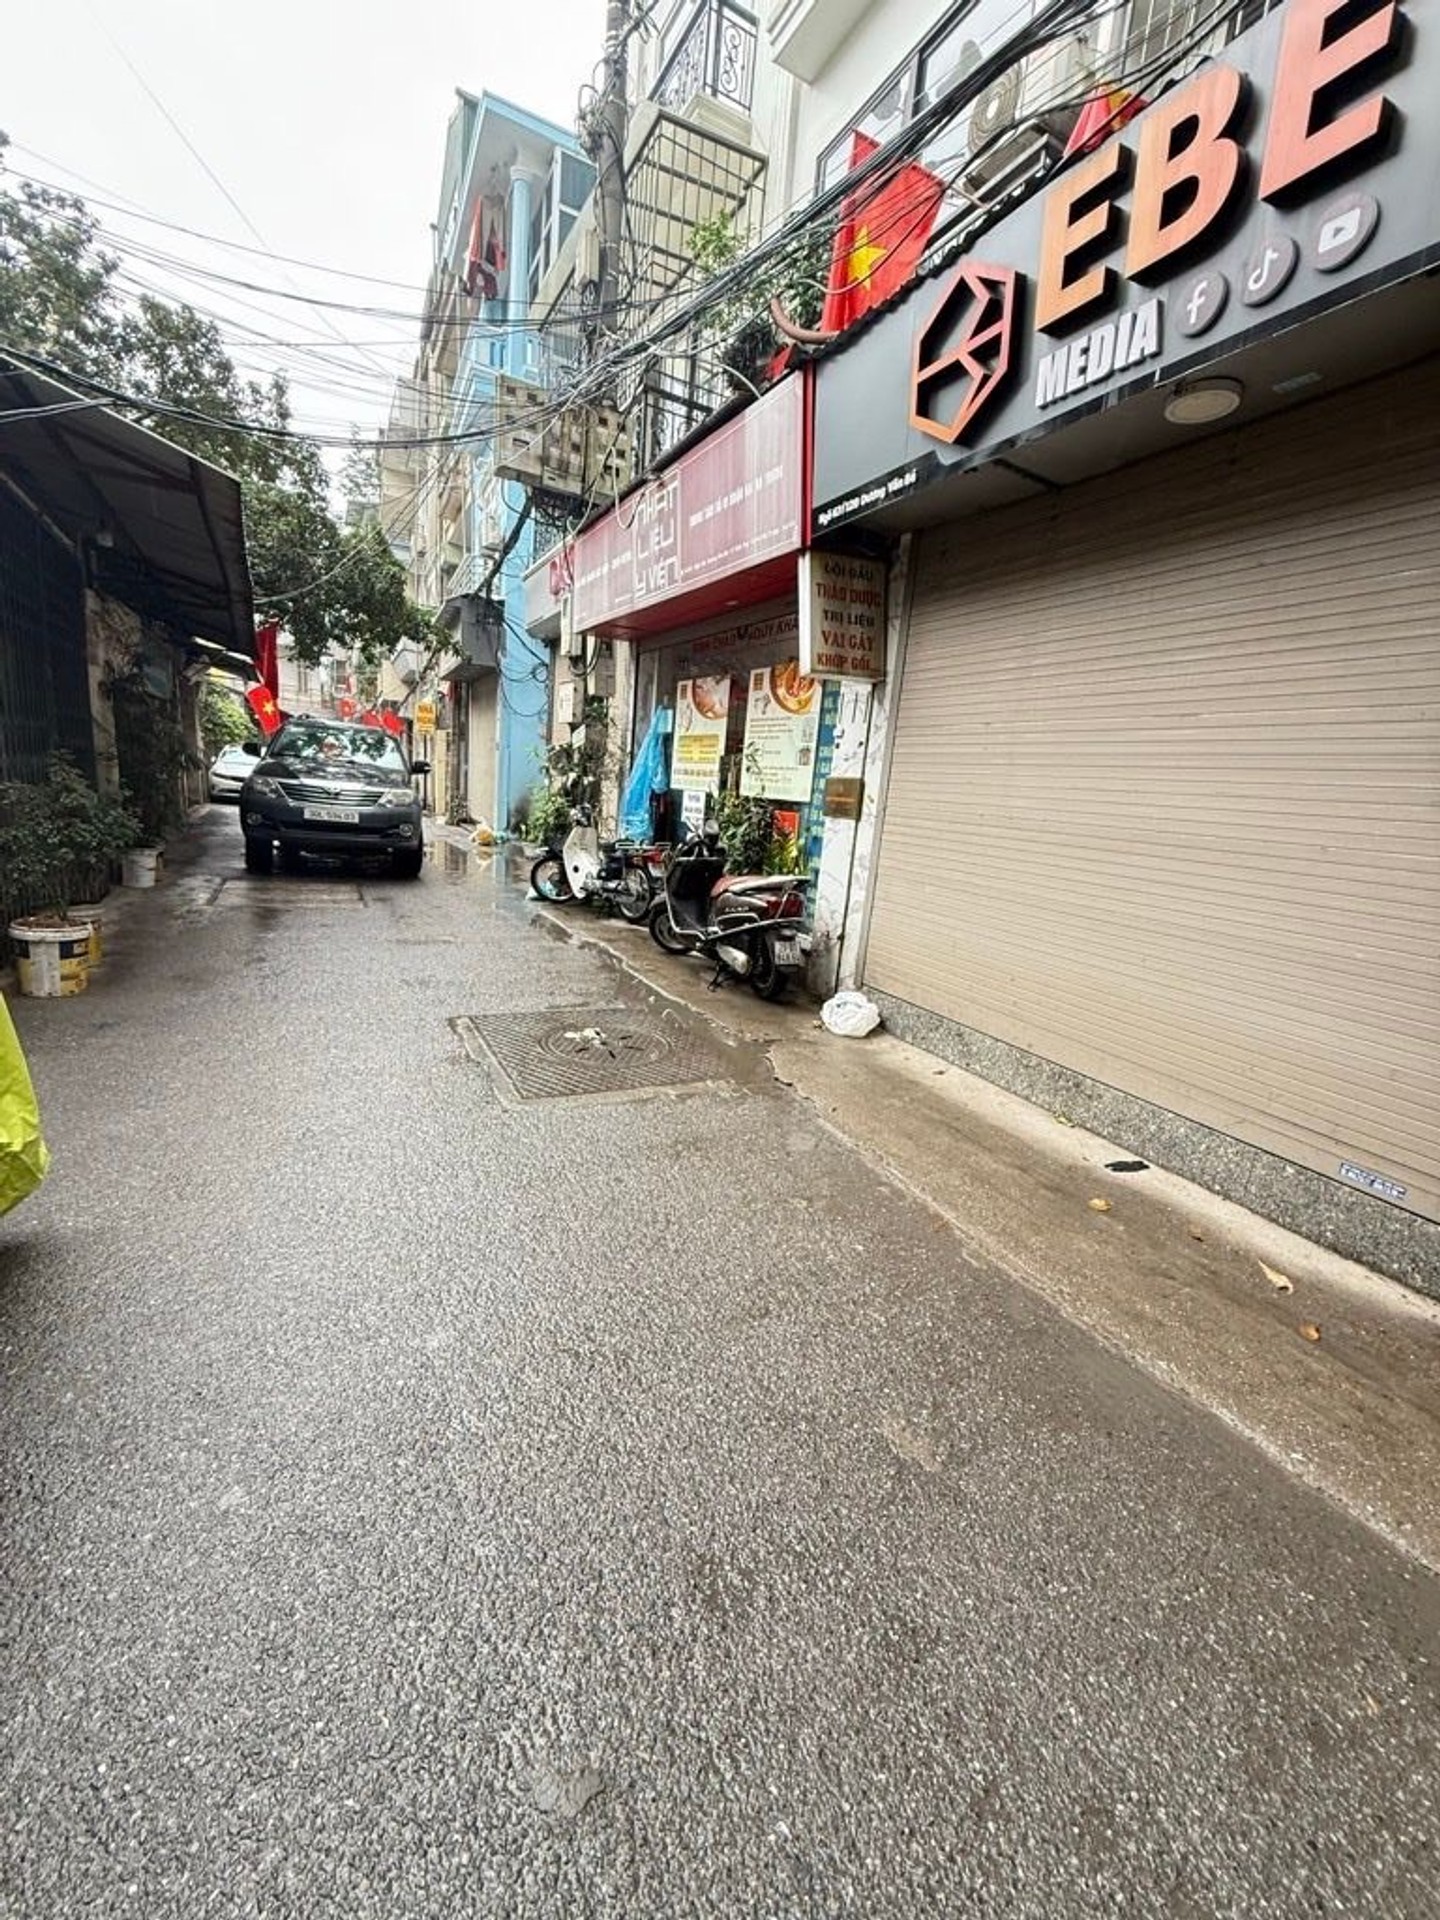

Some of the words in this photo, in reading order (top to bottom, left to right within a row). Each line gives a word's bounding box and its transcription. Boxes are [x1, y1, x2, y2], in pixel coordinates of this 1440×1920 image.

[1035, 0, 1397, 333] EBE
[1035, 298, 1160, 409] MEDIA
[822, 629, 846, 650] VAI
